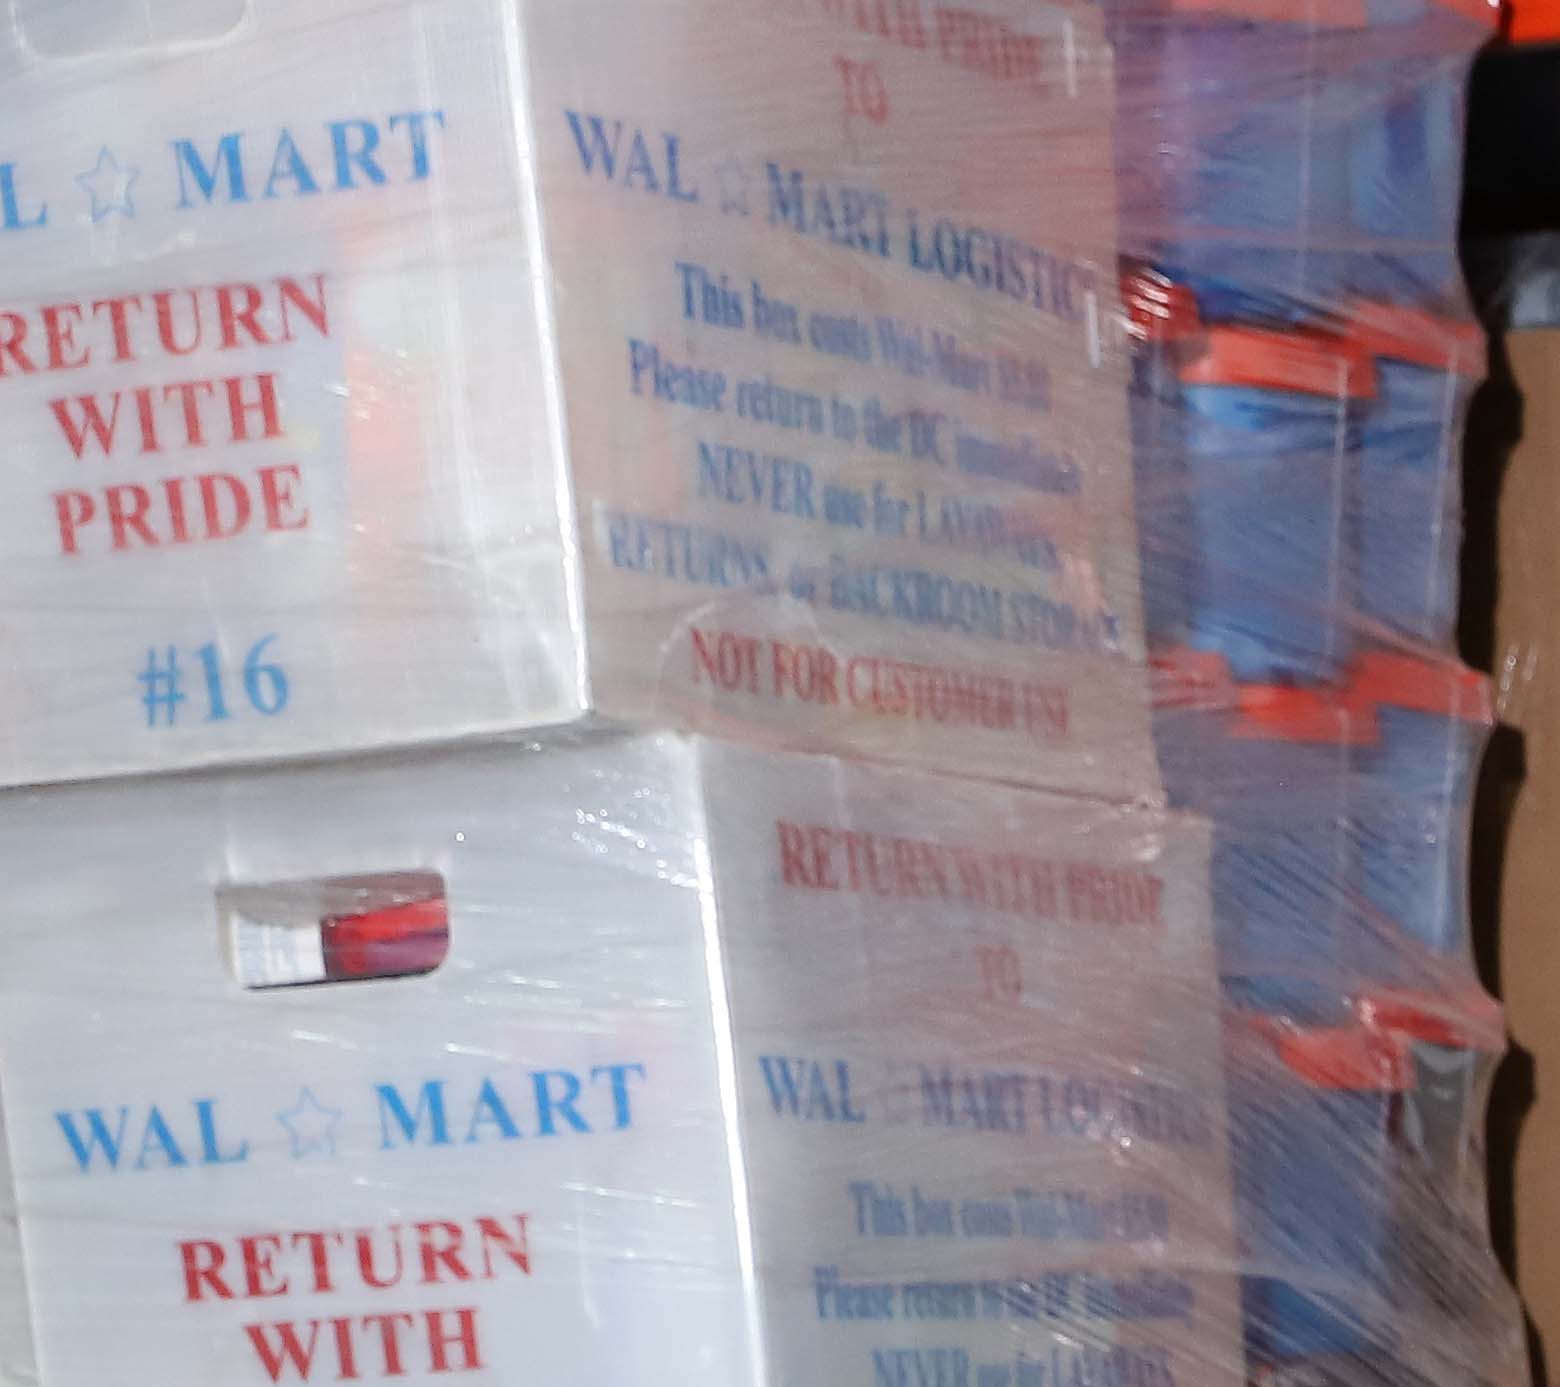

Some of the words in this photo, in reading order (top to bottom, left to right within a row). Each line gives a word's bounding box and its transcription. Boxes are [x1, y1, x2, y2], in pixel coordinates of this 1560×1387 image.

[171, 109, 446, 211] MART
[564, 109, 699, 203] WAL
[766, 161, 892, 259] MART
[0, 273, 331, 378] RETURN
[674, 261, 745, 329] This
[48, 372, 288, 461] WITH
[628, 336, 727, 413] Please
[50, 464, 311, 555] PRIDE
[697, 439, 816, 520] NEVER
[138, 634, 290, 728] #16
[689, 627, 761, 695] NOT
[770, 640, 839, 705] FOR
[776, 819, 950, 902] RETURN
[54, 1097, 250, 1176] WAL
[377, 1062, 647, 1152] MART
[758, 1055, 866, 1124] WAL
[176, 1214, 538, 1305] RETURN
[243, 1306, 487, 1385] WITH
